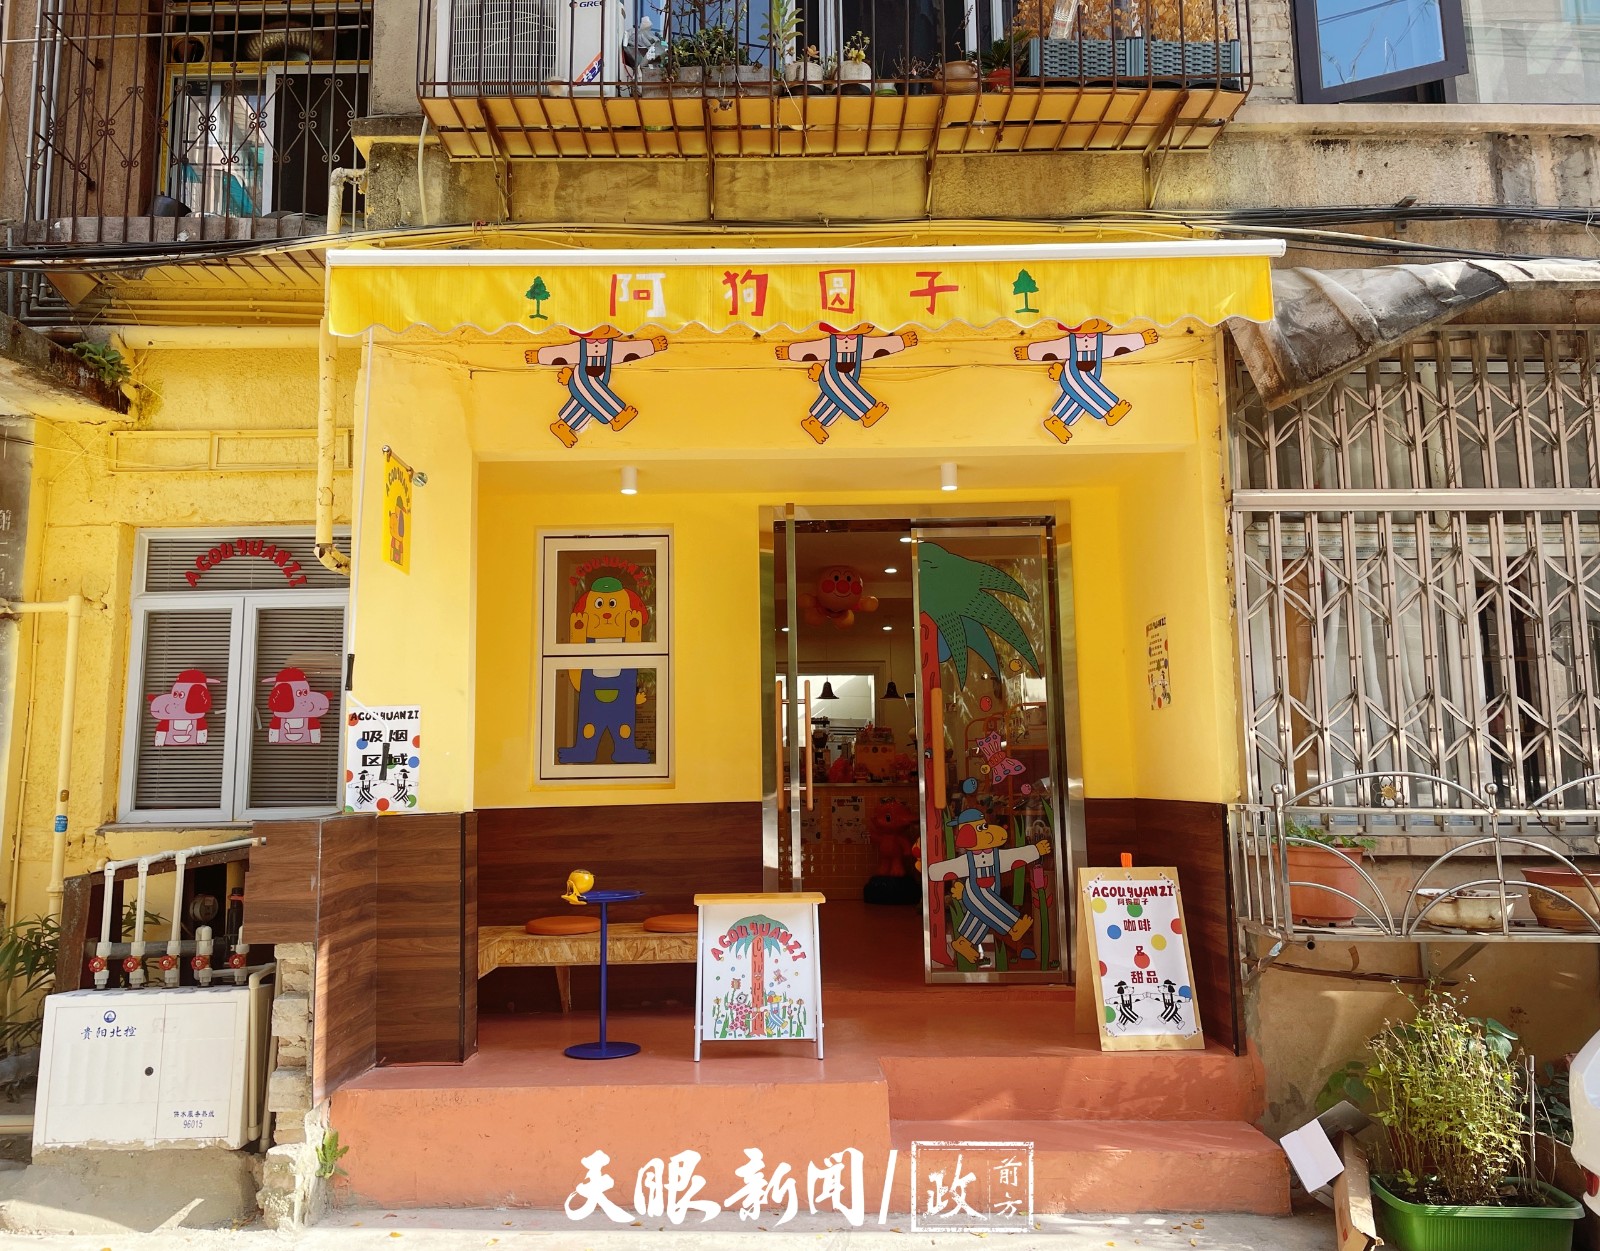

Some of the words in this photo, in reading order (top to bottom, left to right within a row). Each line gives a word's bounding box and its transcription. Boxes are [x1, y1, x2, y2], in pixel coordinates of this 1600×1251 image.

[609, 269, 959, 317] 阿狗圆子
[362, 729, 408, 742] 吸烟
[362, 753, 408, 767] 区域
[1123, 919, 1152, 931] 咖啡
[1130, 970, 1159, 984] 甜品
[183, 1119, 203, 1129] 96015
